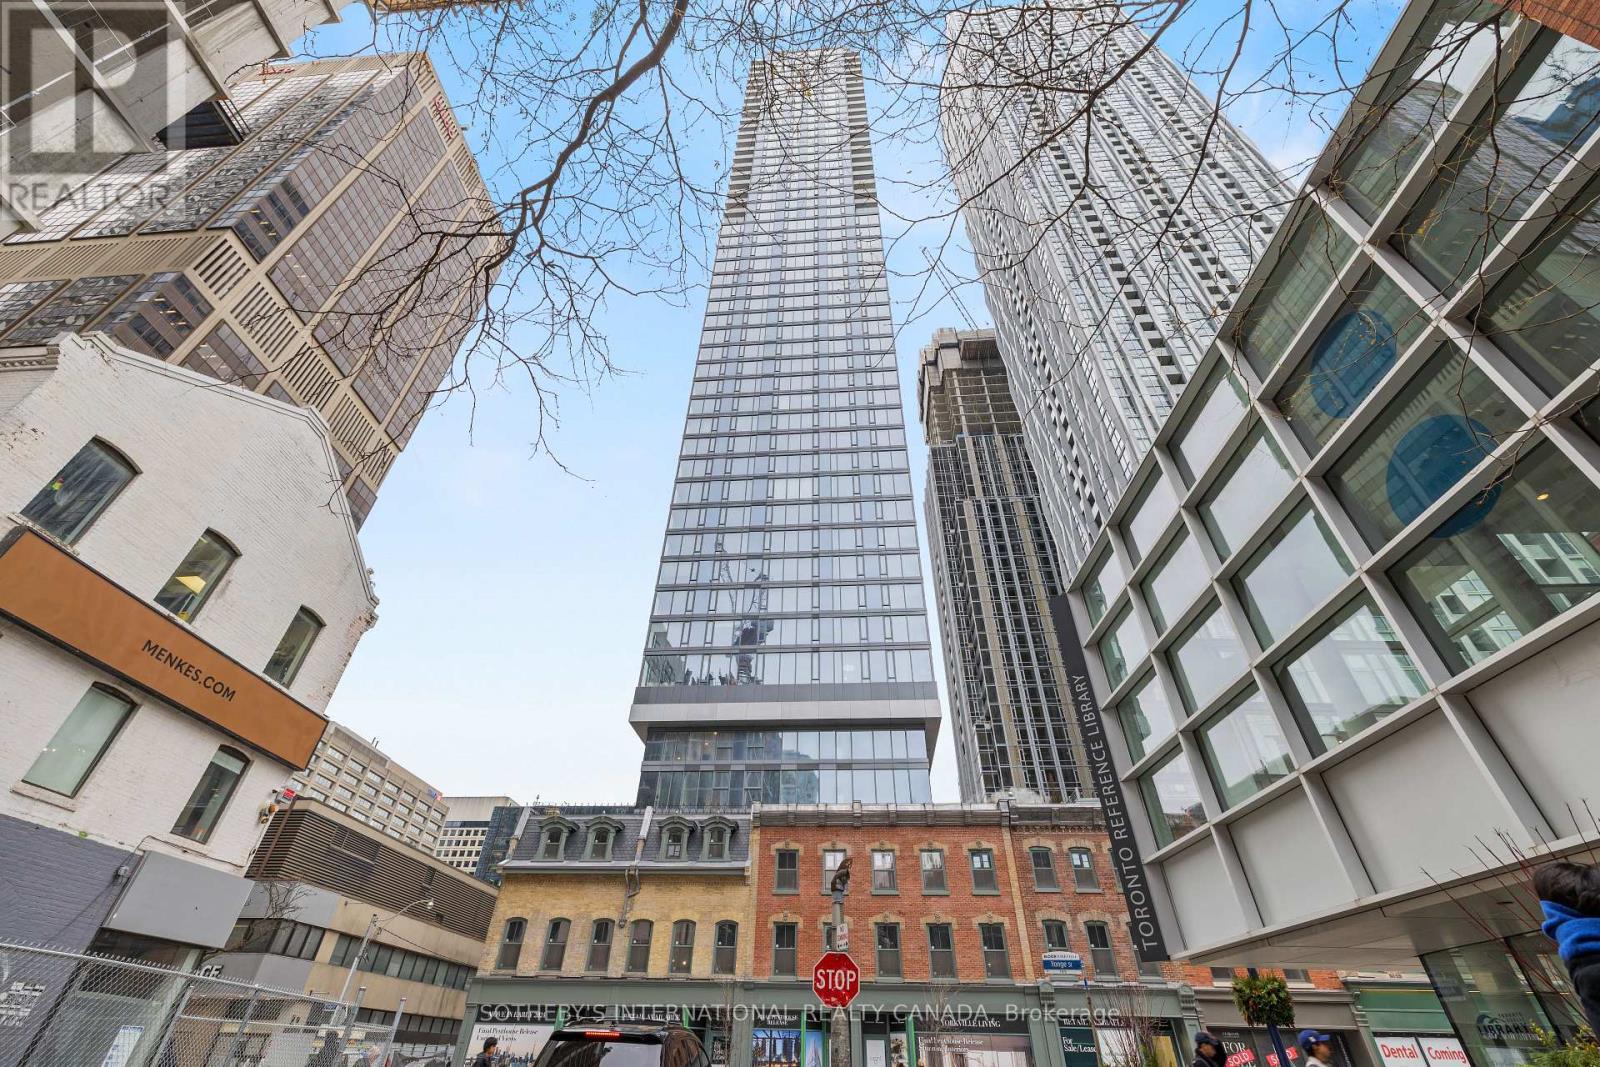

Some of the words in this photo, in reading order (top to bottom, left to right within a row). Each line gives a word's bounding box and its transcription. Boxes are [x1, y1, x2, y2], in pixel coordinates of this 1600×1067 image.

[142, 640, 236, 702] MENKES.COM
[1072, 674, 1100, 737] LIBRARY
[1091, 740, 1129, 840] REFERENCE
[1119, 847, 1158, 952] TORONTO
[816, 968, 857, 991] STOP
[940, 1018, 977, 1027] YORKVILLE
[979, 1018, 1000, 1028] LIVING
[1062, 1036, 1073, 1044] For
[1222, 1041, 1246, 1053] FOR
[1063, 1045, 1097, 1053] Sale/Lease
[1270, 1049, 1293, 1064] SD
[1380, 1044, 1418, 1059] Dental
[1427, 1046, 1467, 1064] Coming
[1228, 1052, 1249, 1066] SOLD
